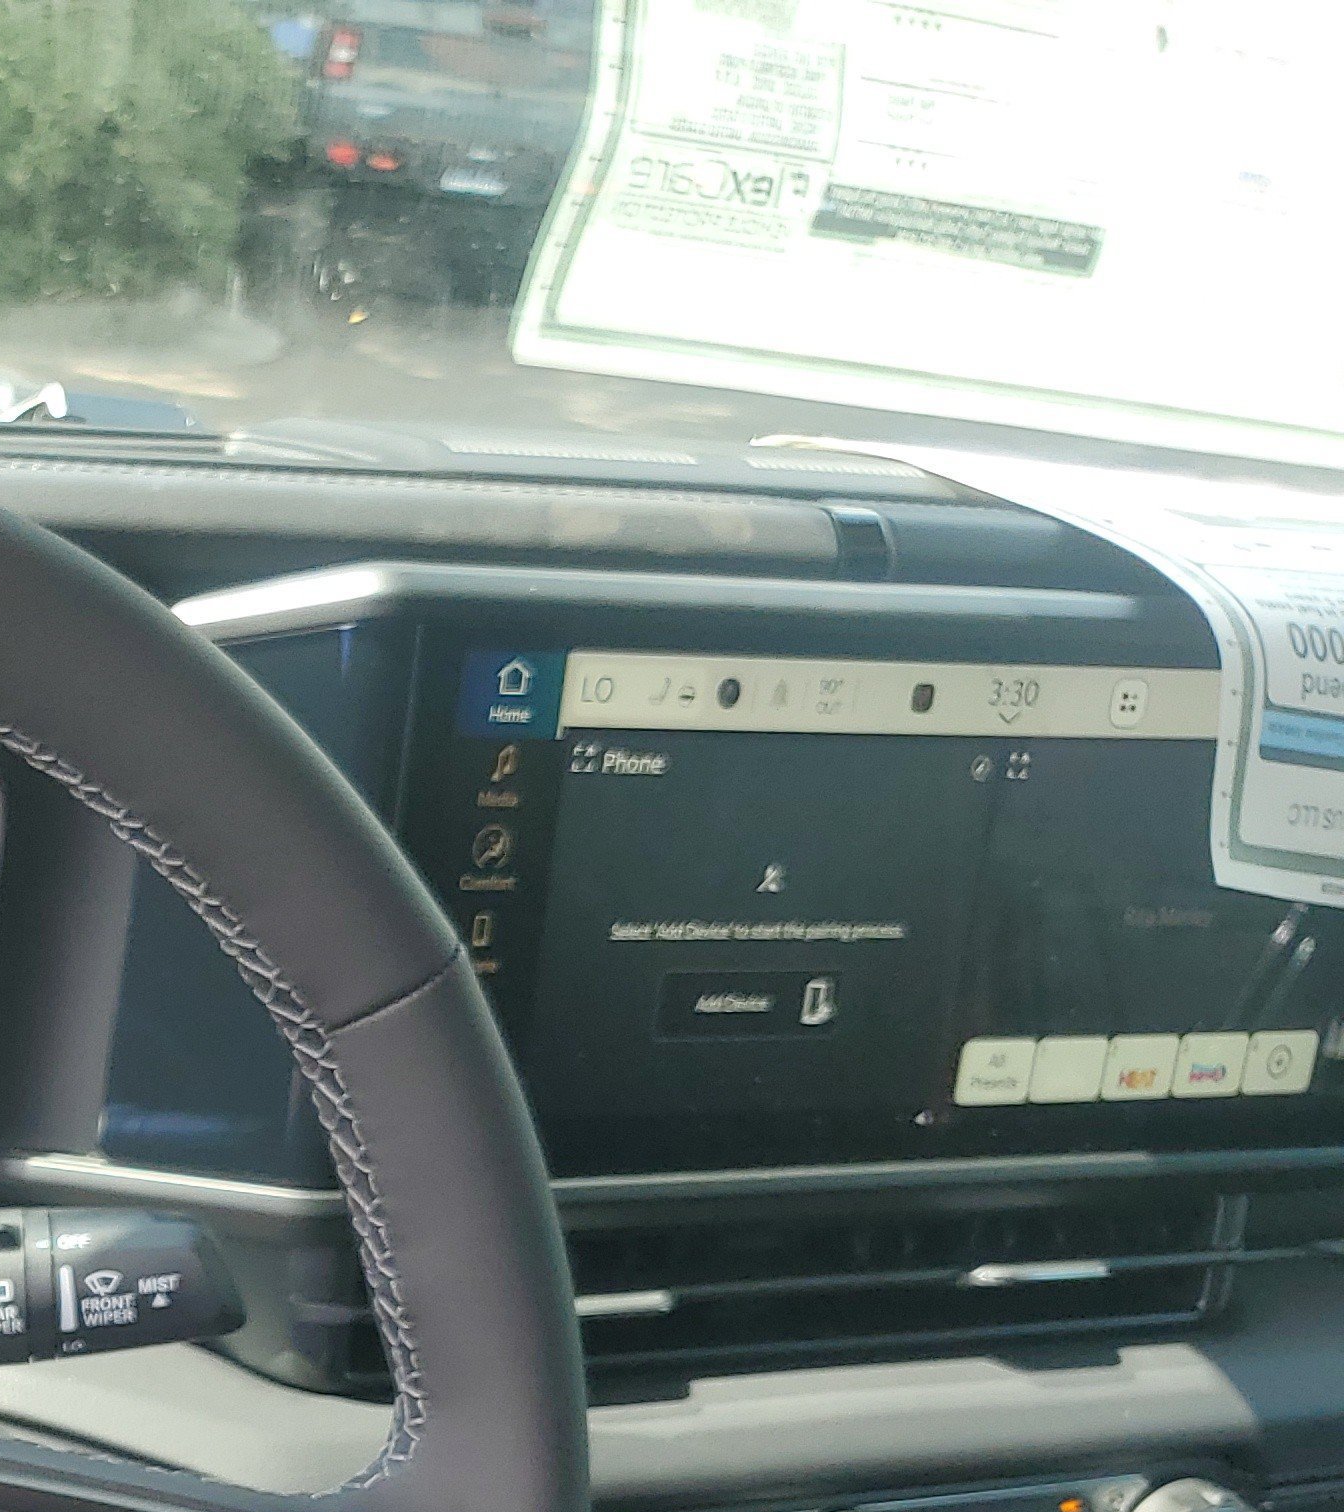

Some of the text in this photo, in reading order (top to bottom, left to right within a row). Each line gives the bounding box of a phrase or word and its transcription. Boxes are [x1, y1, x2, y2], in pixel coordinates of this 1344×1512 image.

[988, 679, 1039, 707] 3:30
[489, 705, 533, 723] Home
[602, 751, 667, 775] Phone
[138, 1273, 182, 1294] MIST
[81, 1293, 136, 1314] FRONT
[83, 1309, 138, 1328] WIPER
